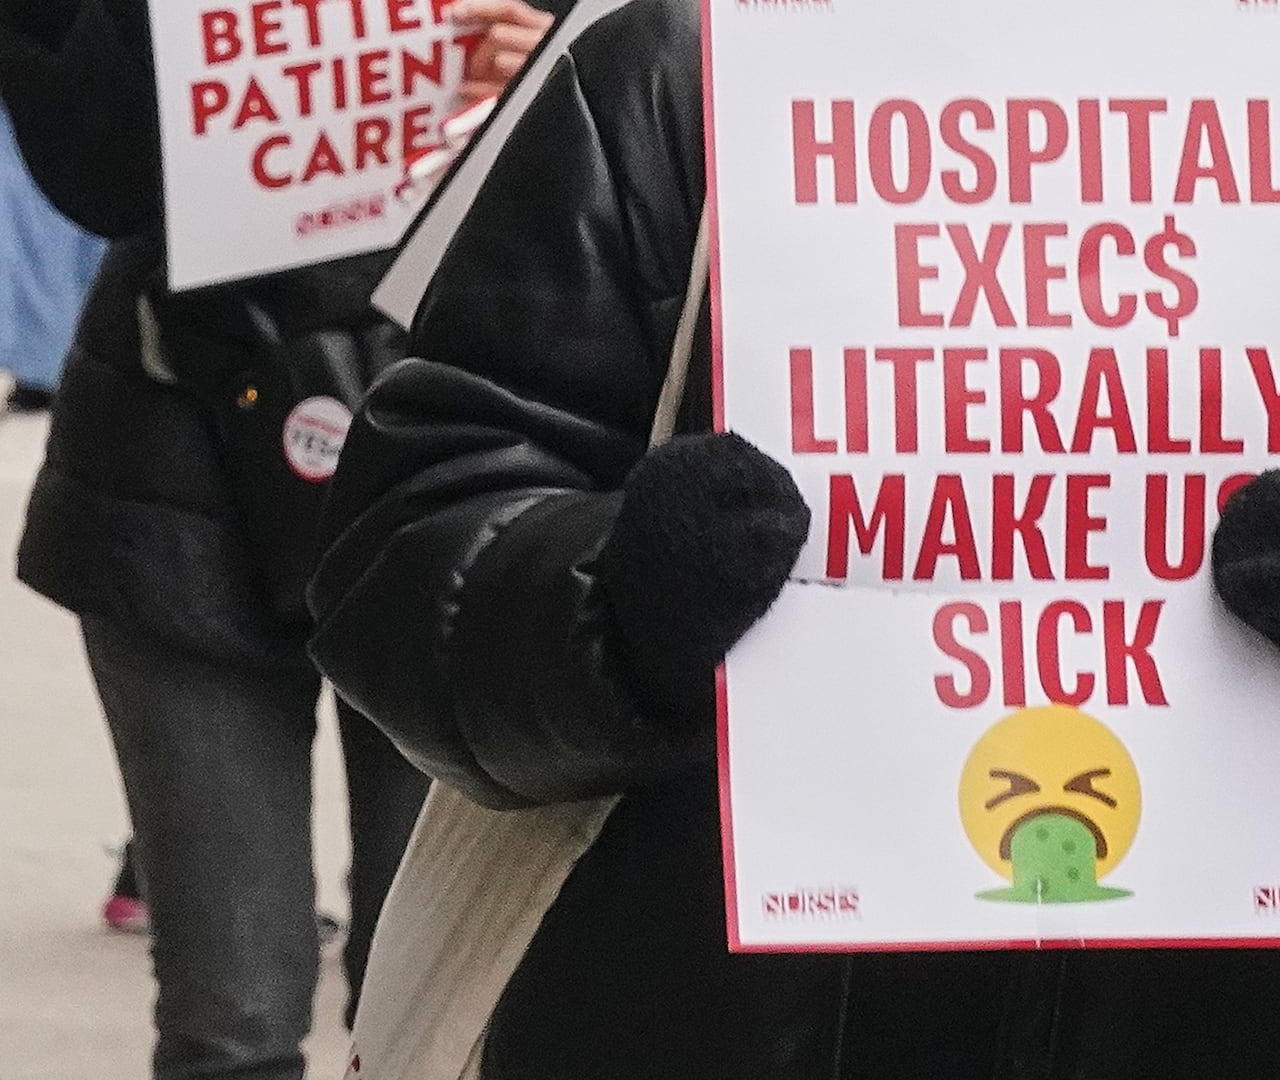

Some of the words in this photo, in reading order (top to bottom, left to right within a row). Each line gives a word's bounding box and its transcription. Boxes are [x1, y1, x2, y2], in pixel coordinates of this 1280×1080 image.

[894, 214, 1198, 336] EXEC$
[825, 472, 1110, 581] MAKE
[1142, 472, 1256, 581] U
[932, 598, 1170, 710] SICK
